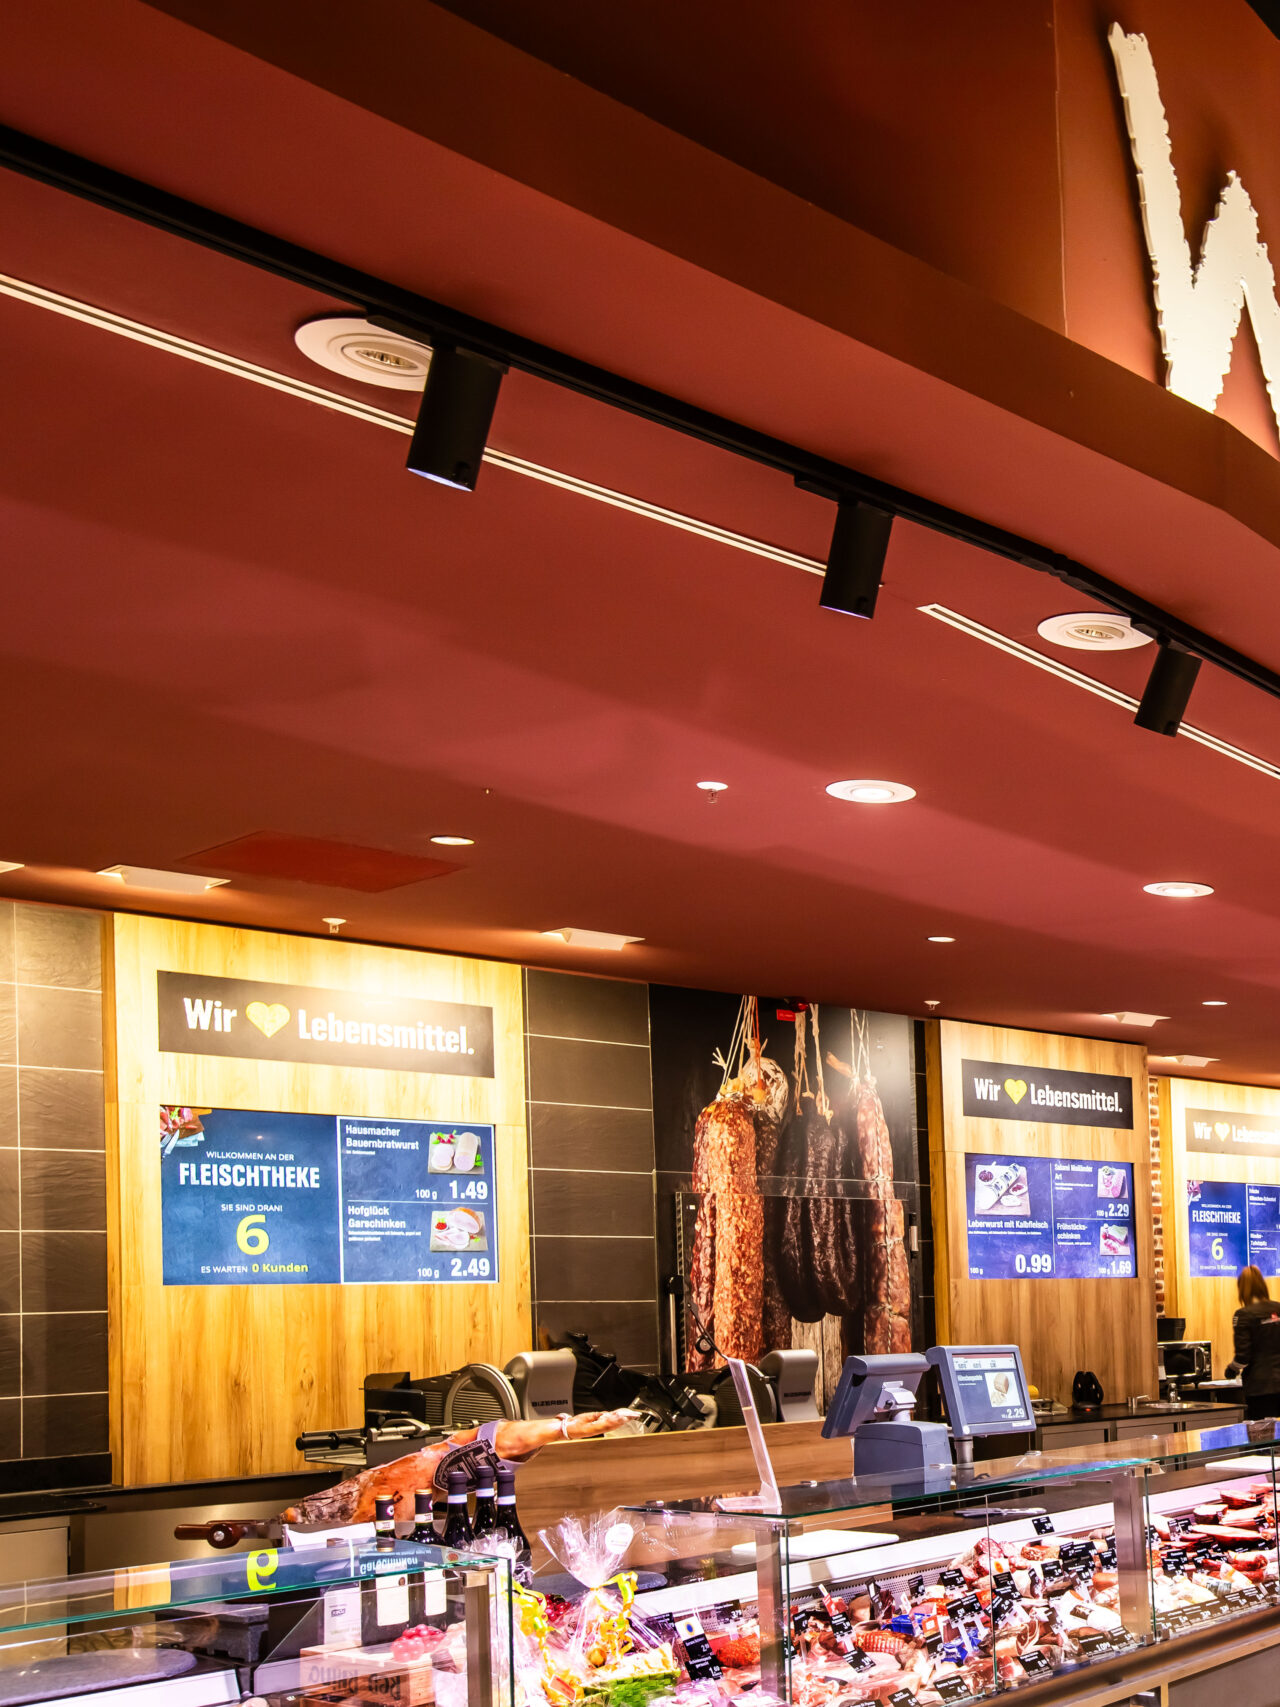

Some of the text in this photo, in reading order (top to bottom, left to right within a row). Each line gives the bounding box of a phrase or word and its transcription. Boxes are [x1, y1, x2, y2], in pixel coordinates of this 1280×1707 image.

[184, 998, 475, 1055] Wir Lebensmittel.
[974, 1077, 1123, 1113] Wir Lebensmittel.
[345, 1124, 401, 1137] Hausmacher
[1193, 1121, 1212, 1140] Wir
[345, 1137, 420, 1150] Bauernbratwurst
[206, 1151, 294, 1161] WILLKOMMEN AN DER
[179, 1163, 320, 1188] FLEISCHTHEKE
[415, 1189, 438, 1200] 100 g
[449, 1180, 488, 1200] 1.49
[221, 1204, 283, 1212] SIE SIND DRAN!
[348, 1205, 390, 1218] Hofglück
[1108, 1203, 1130, 1217] 2.29
[348, 1219, 406, 1229] Garschinken
[1192, 1210, 1241, 1224] FLEISCHTHEKE
[236, 1214, 270, 1255] 6
[1211, 1238, 1223, 1260] 6
[201, 1263, 308, 1274] ES WARTEN 0 Kunden
[451, 1258, 490, 1277] 2.49
[1015, 1254, 1052, 1273] 0.99
[1111, 1260, 1132, 1274] 1.69
[417, 1268, 440, 1278] 100 g
[1006, 1408, 1025, 1418] 2.29
